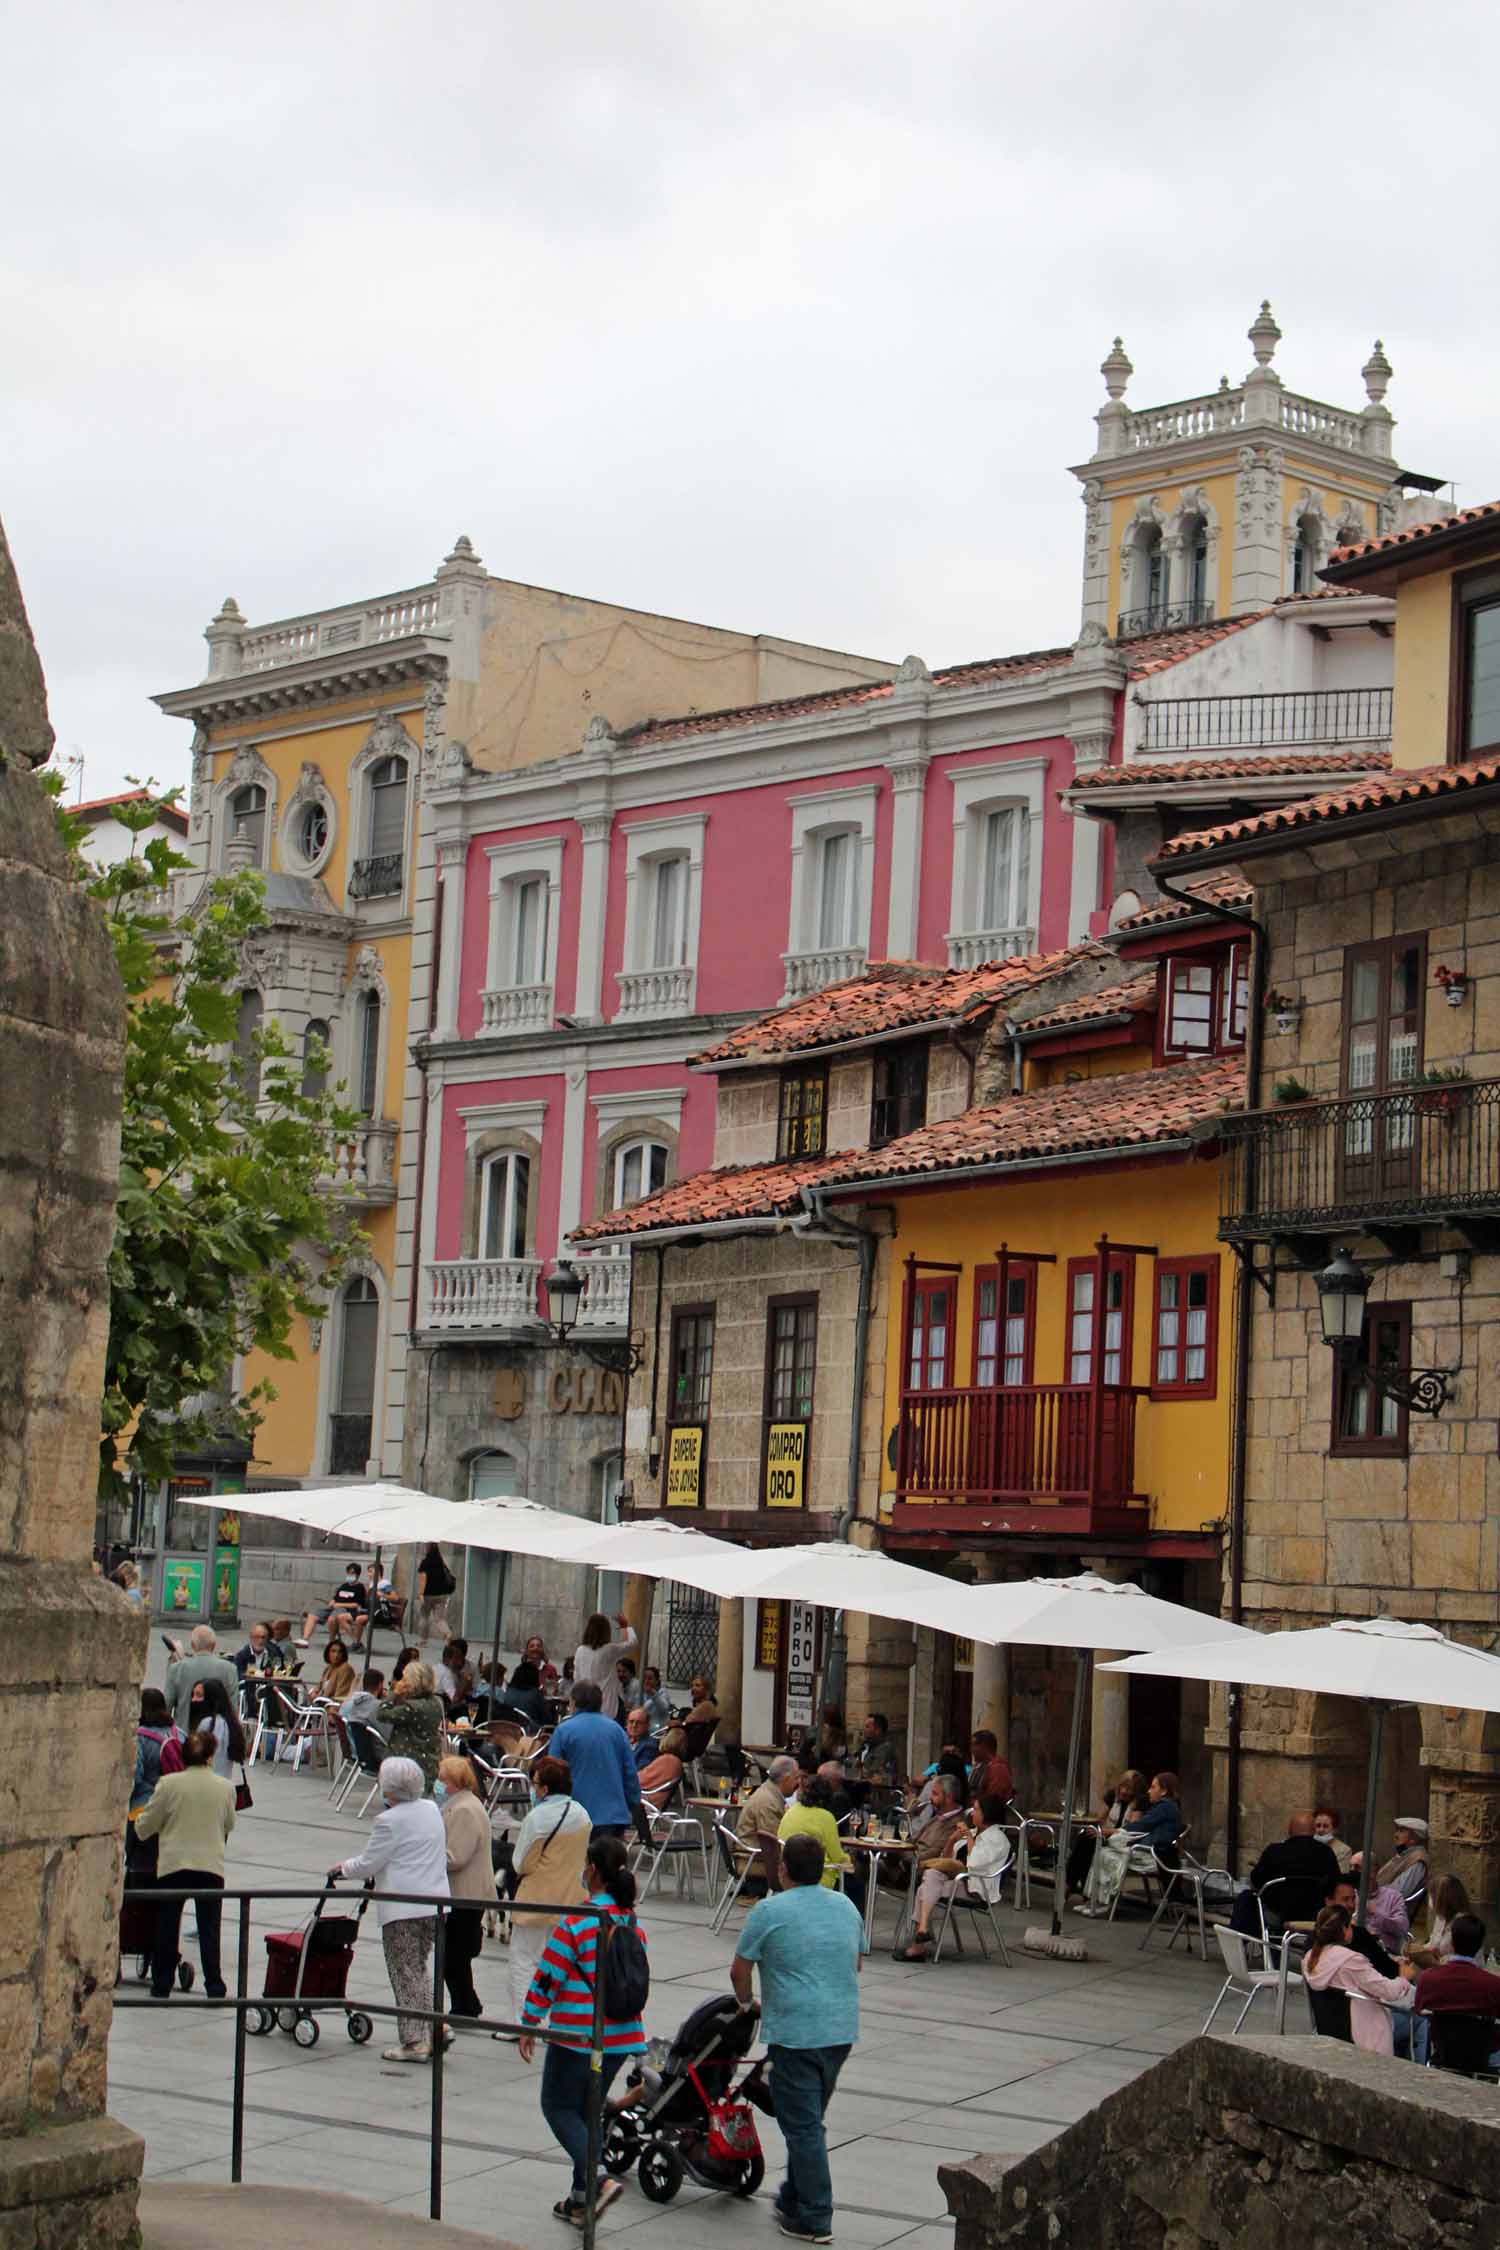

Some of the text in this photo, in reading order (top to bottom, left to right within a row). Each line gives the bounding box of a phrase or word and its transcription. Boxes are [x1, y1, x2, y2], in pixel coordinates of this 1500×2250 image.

[769, 1432, 802, 1461] COMPRO
[669, 1468, 697, 1492] SUS JOYAS
[770, 1470, 795, 1499] ORO
[792, 1605, 801, 1666] MPRO
